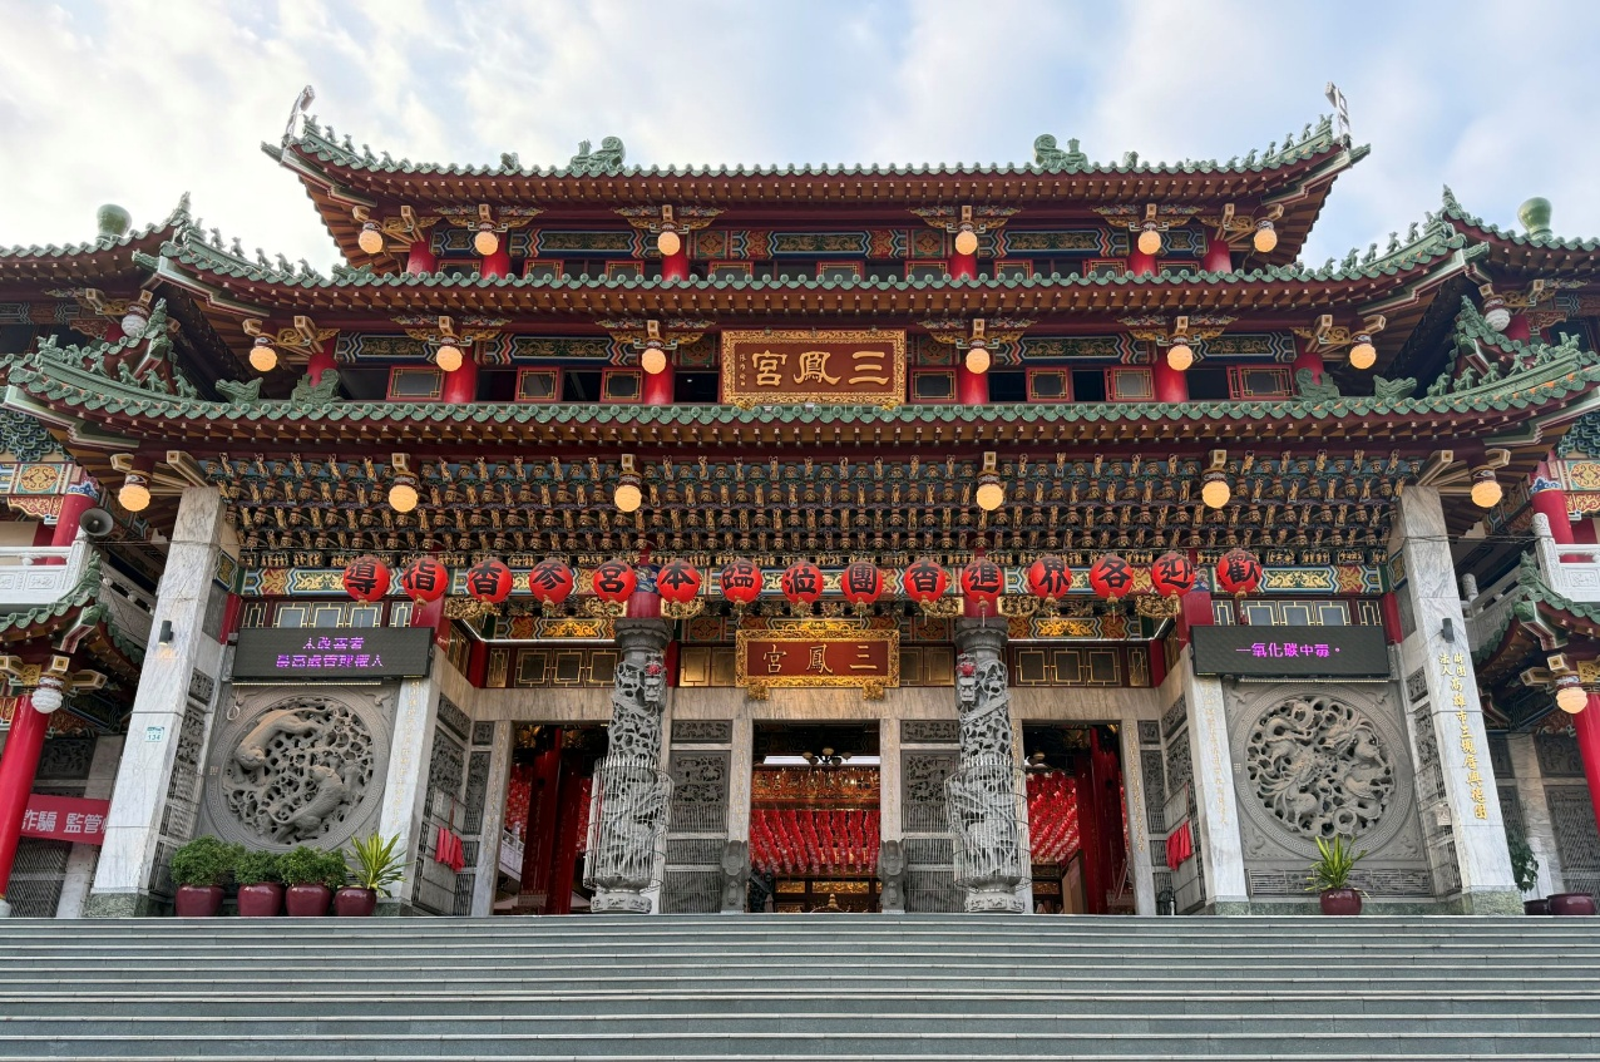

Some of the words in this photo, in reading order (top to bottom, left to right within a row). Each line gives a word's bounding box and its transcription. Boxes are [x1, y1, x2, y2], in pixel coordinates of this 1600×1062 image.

[751, 350, 889, 387] 三鳳宮
[403, 561, 436, 592] 指
[470, 561, 502, 595] 香
[661, 561, 695, 591] 本
[849, 562, 877, 594] 團
[911, 560, 939, 592] 香
[968, 562, 999, 593] 進
[1039, 557, 1070, 593] 界
[1098, 557, 1131, 589] 各
[763, 644, 878, 674] 三鳳宮
[64, 812, 107, 834] 監管
